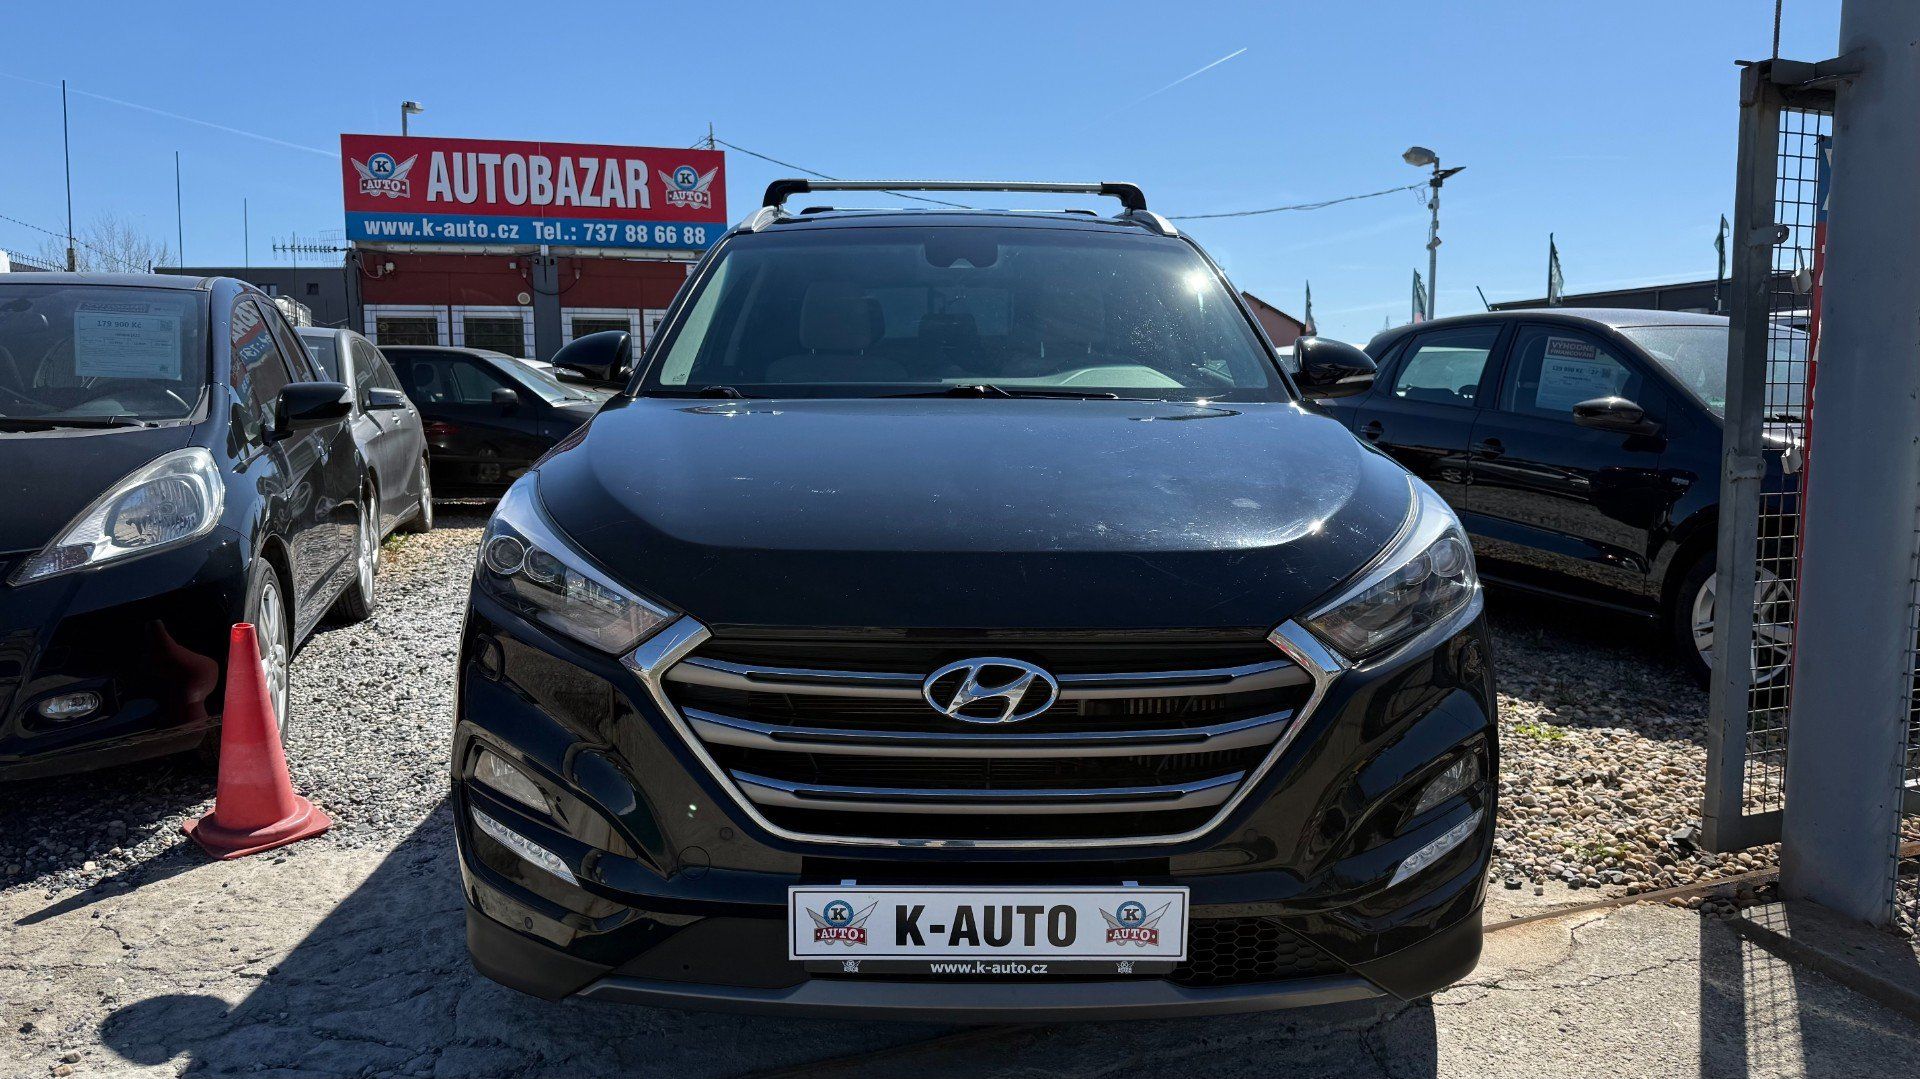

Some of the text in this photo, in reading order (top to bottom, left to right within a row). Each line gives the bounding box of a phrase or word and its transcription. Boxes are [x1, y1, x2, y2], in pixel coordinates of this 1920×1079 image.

[374, 160, 389, 173] K
[427, 150, 651, 210] AUTOBAZAR
[680, 172, 693, 184] K
[366, 179, 401, 192] AUTO
[672, 190, 703, 203] AUTO
[364, 218, 706, 245] www.k-auto.cz Tel.: 737 88 66 88
[831, 907, 847, 921] K
[1123, 908, 1140, 921] K
[895, 904, 1077, 947] K-AUTO
[820, 928, 859, 940] AUTO
[1112, 928, 1151, 941] AUTO
[930, 961, 1048, 974] www.k-auto.cz
